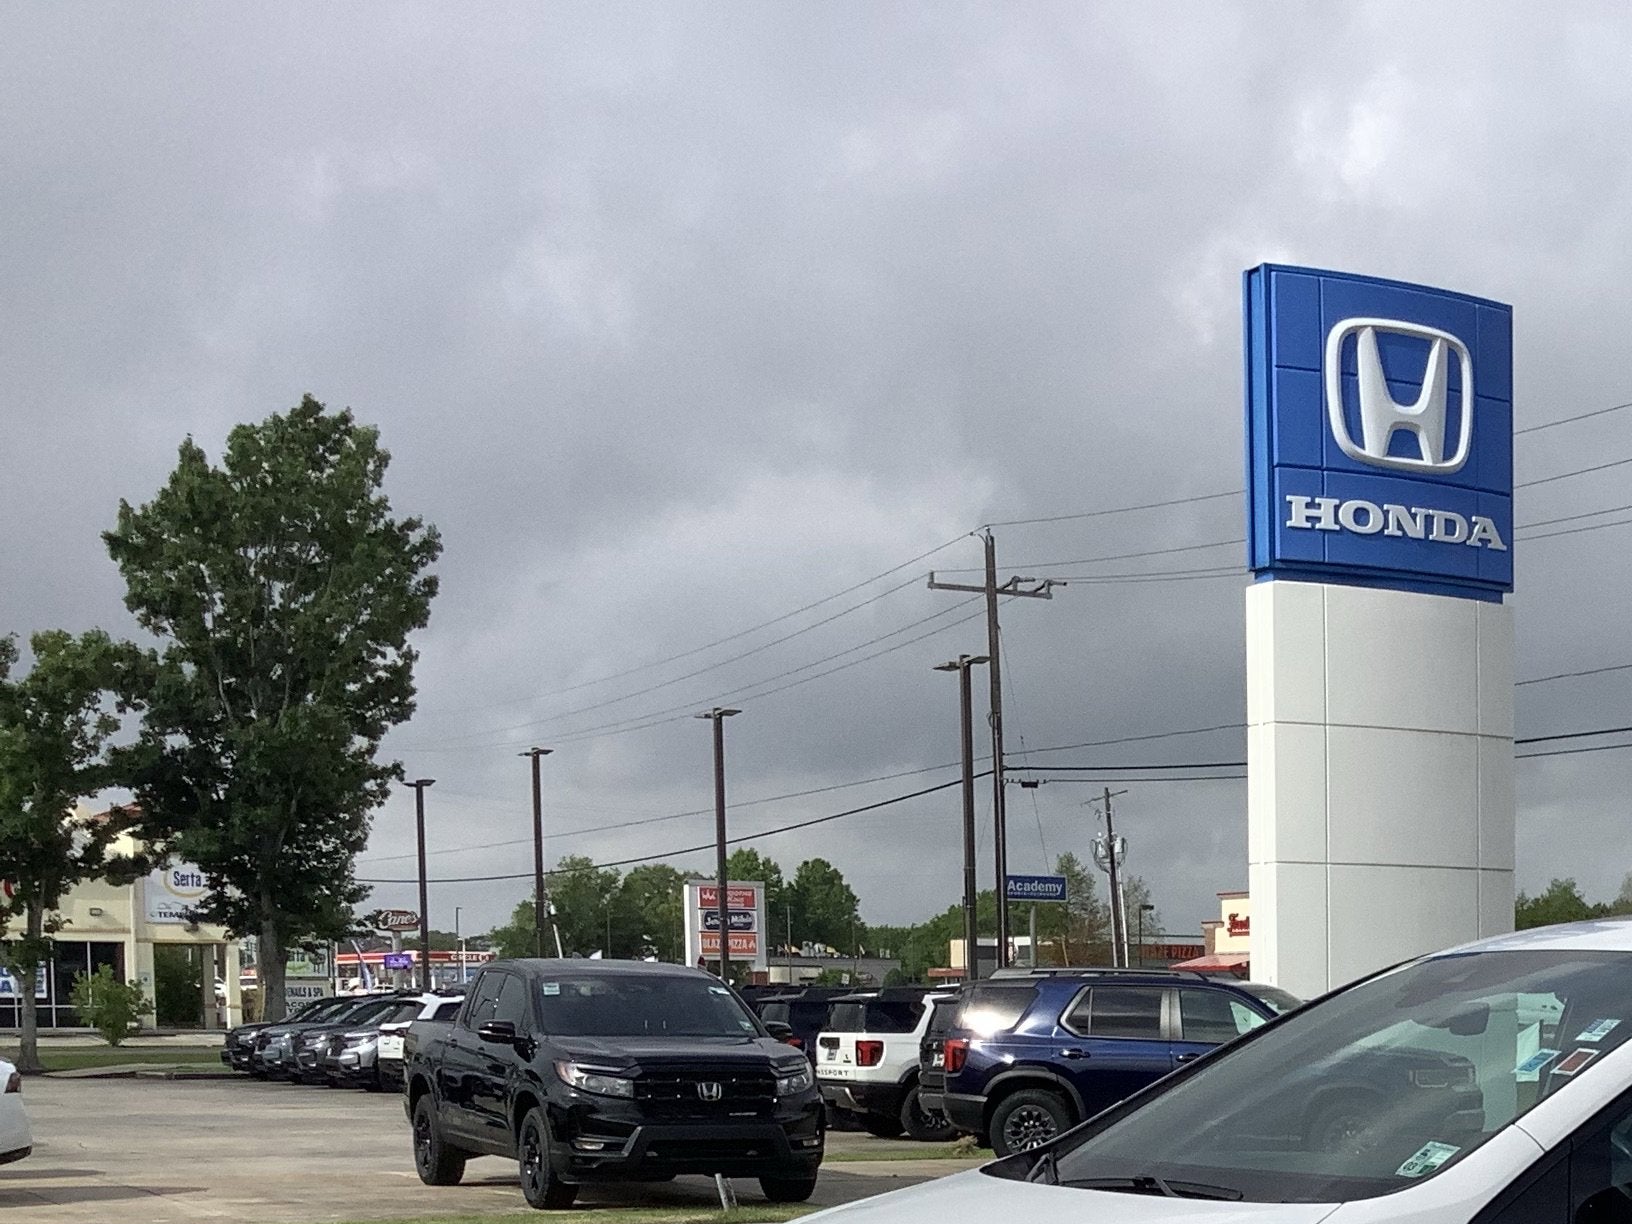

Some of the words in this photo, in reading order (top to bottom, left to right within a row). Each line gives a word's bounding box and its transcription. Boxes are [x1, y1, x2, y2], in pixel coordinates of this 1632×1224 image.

[1286, 496, 1508, 551] HONDA
[174, 871, 202, 887] Serta
[1007, 880, 1063, 896] Academy
[378, 910, 417, 929] Cane's
